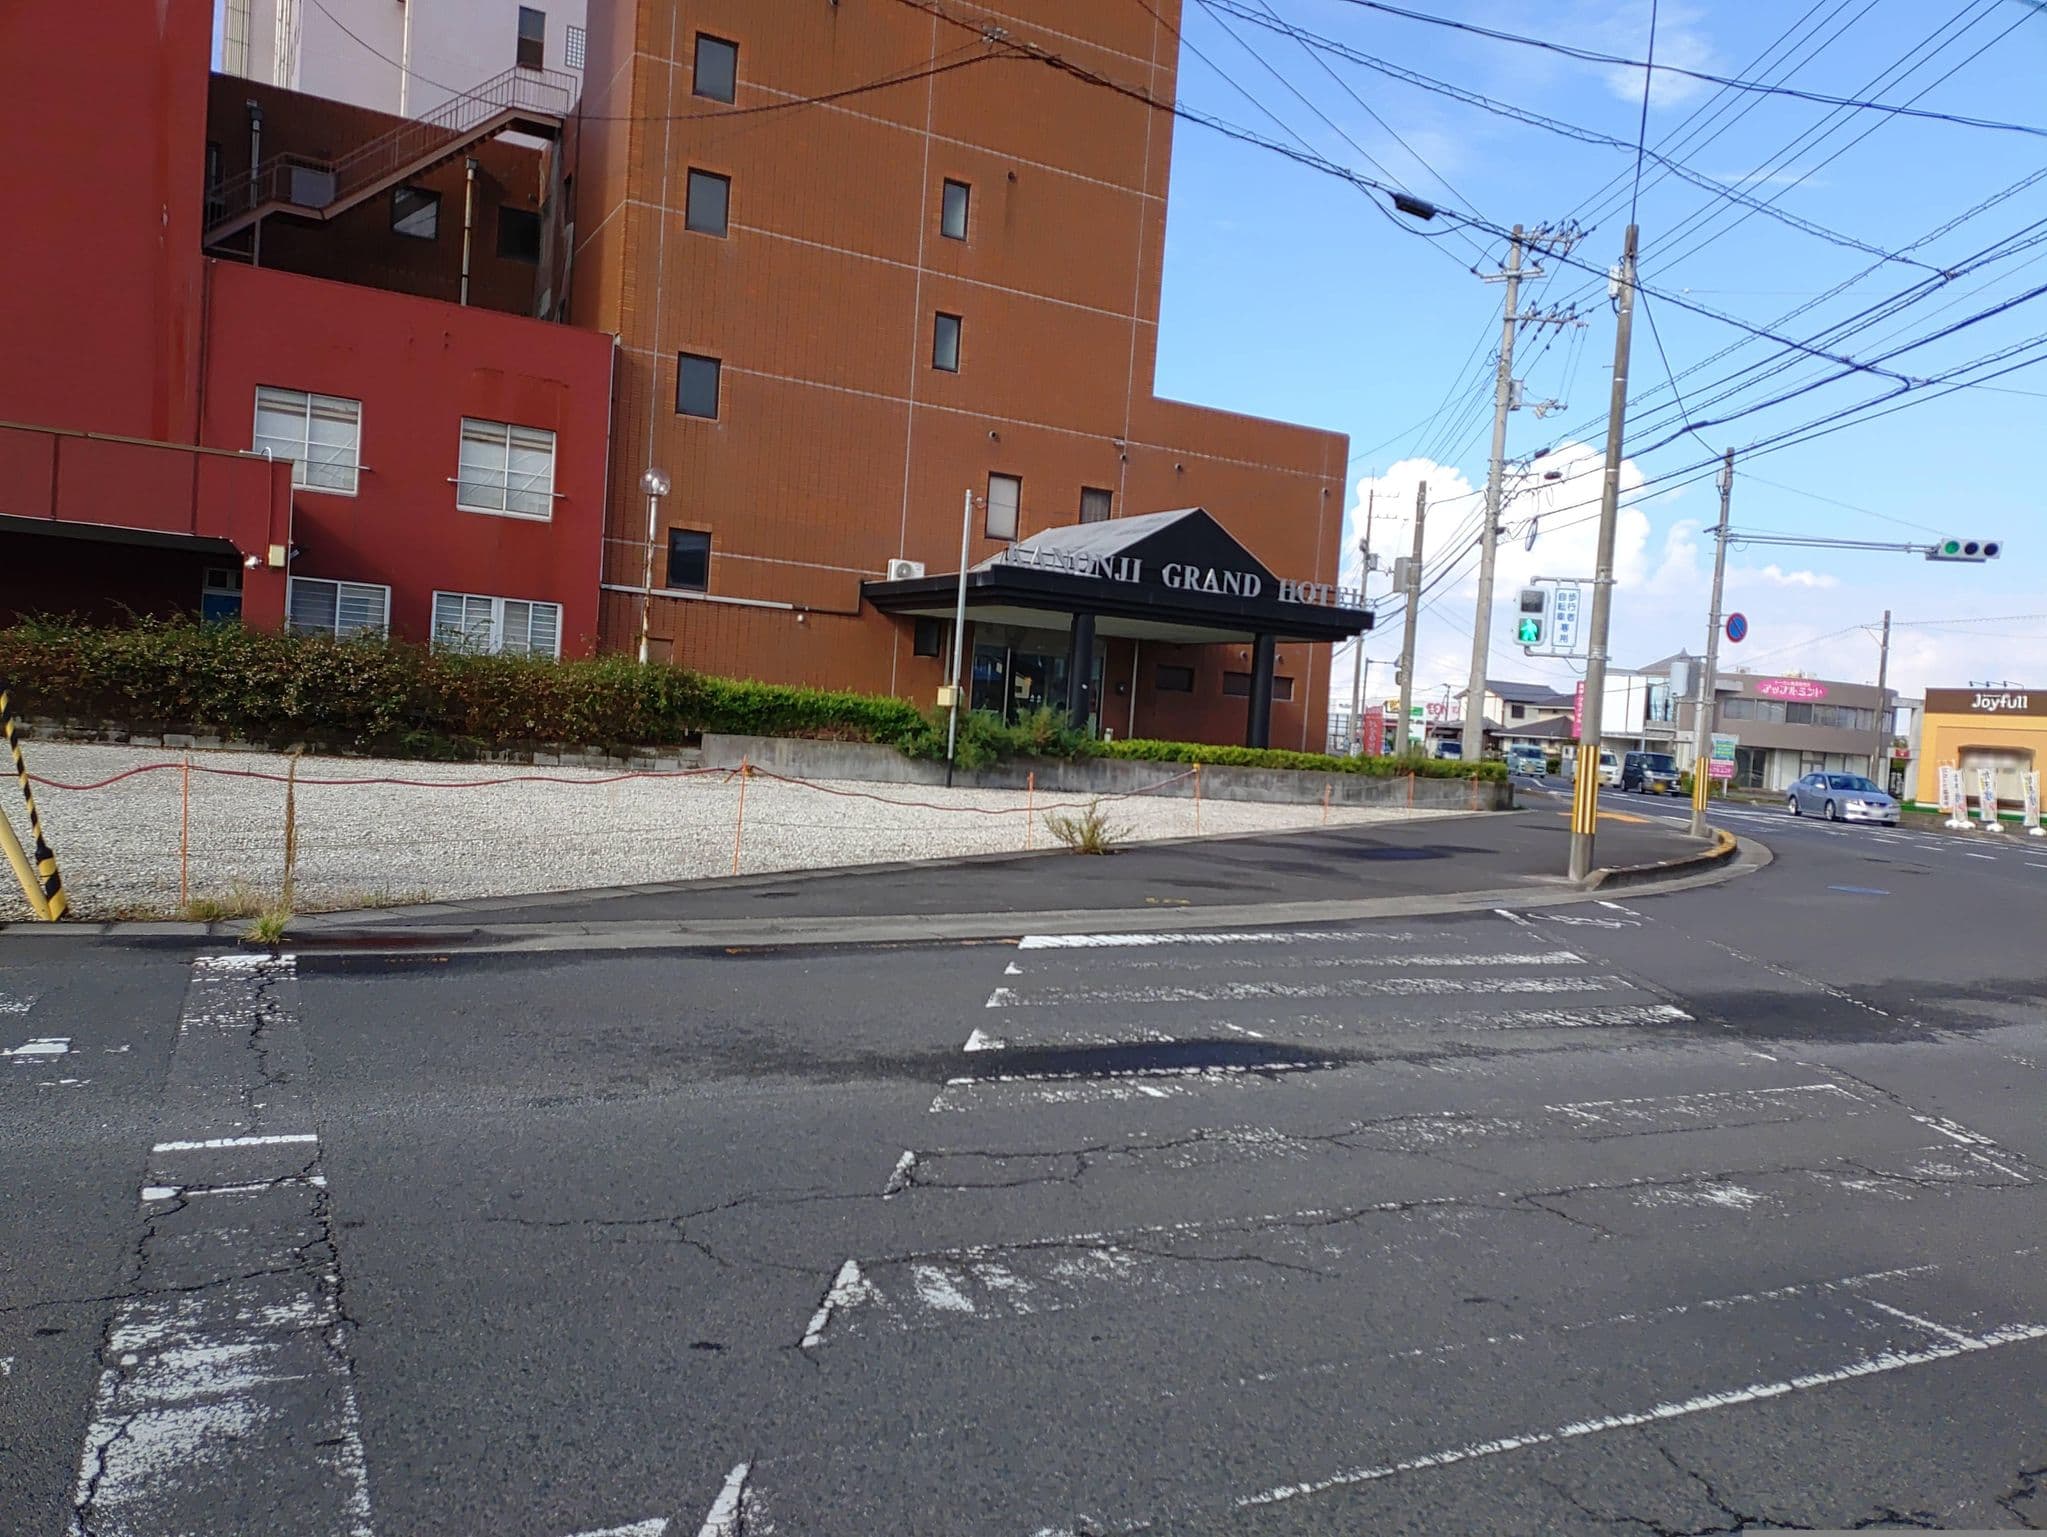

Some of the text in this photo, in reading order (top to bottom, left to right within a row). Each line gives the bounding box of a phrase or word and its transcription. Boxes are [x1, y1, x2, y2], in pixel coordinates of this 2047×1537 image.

[1162, 563, 1261, 597] GRAND
[1567, 593, 1577, 622] 歩行者
[1971, 693, 2029, 711] Joyfull
